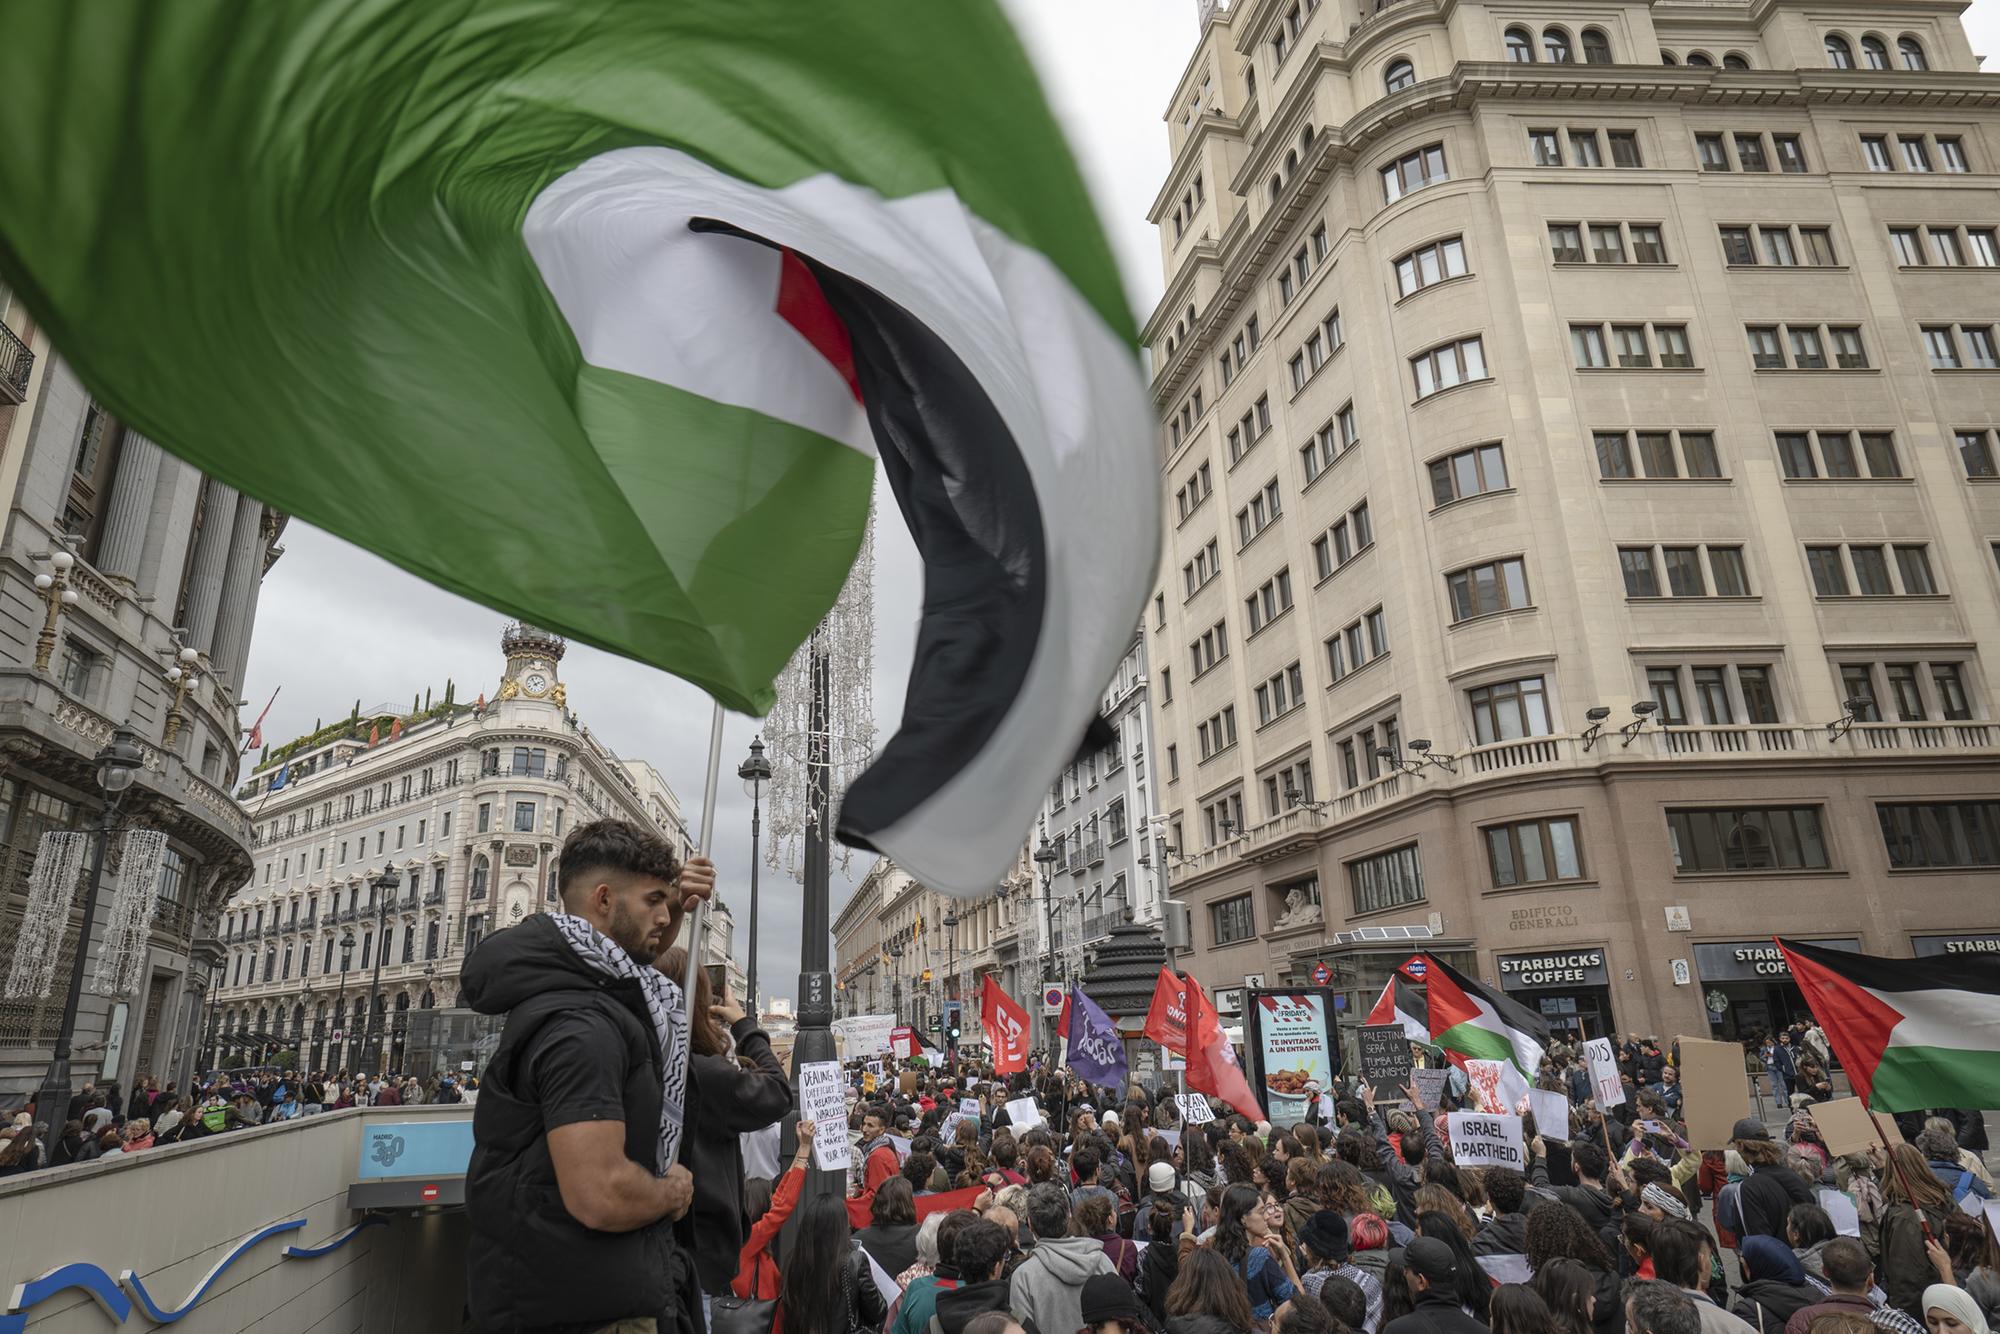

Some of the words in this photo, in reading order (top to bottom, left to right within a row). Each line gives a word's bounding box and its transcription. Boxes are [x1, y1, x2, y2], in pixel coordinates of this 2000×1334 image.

[1511, 905, 1573, 920] EDIFICIO
[1509, 916, 1579, 931] GENERALI
[1946, 940, 2000, 953] STARB
[1501, 954, 1601, 973] STARBUCKS
[1521, 969, 1585, 984] COFFEE
[931, 1016, 939, 1025] P
[1281, 1037, 1319, 1046] INVITAMOS
[1362, 1030, 1406, 1041] PALESTINA
[1287, 1045, 1322, 1053] ENTRANTE
[1390, 1043, 1400, 1052] LA
[1365, 1056, 1392, 1067] TUMBA
[1394, 1055, 1409, 1065] DEL
[803, 1069, 833, 1087] DEALING
[1369, 1066, 1409, 1079] SIONISMO
[805, 1084, 835, 1100] DIFFICULT
[806, 1100, 812, 1110] A
[1462, 1121, 1508, 1142] ISRAEL,
[824, 1134, 845, 1146] MAKES
[824, 1149, 839, 1163] YOUR
[1454, 1142, 1521, 1163] APARTHEID.
